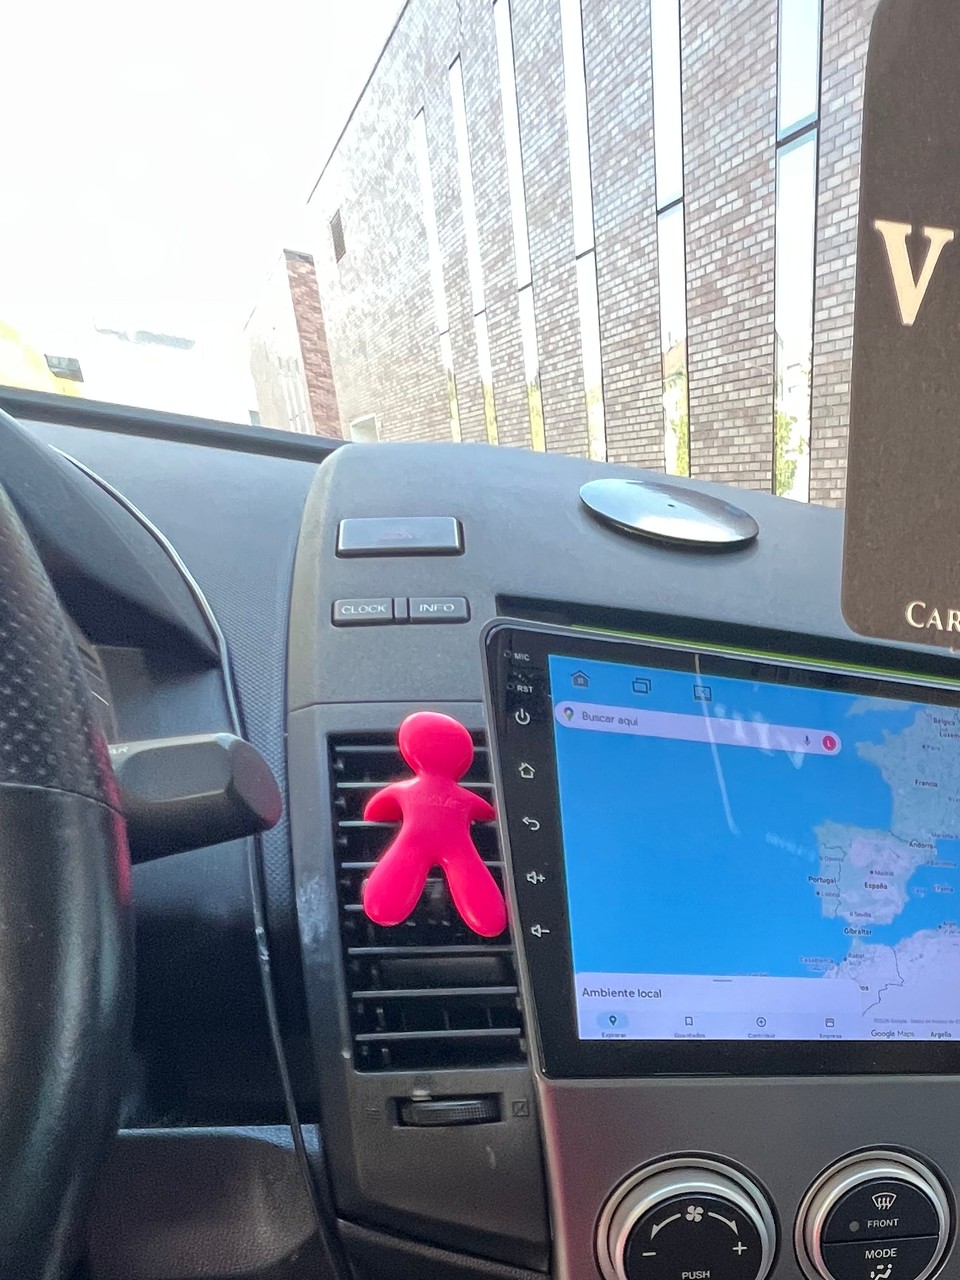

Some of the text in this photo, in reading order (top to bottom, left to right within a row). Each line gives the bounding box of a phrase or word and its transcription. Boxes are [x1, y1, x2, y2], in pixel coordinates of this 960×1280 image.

[341, 603, 387, 615] CLOCK
[418, 603, 455, 612] INFO
[513, 652, 530, 662] MIC
[516, 684, 533, 694] RST
[582, 711, 615, 723] Buscar
[914, 779, 938, 788] Francia
[908, 841, 934, 850] Andorra
[874, 869, 895, 877] Madrid
[808, 875, 837, 885] Portugal
[864, 881, 888, 890] España
[843, 927, 872, 935] Gibraltar
[582, 987, 662, 998] Ambiente local
[870, 1029, 915, 1039] Google Maps
[930, 1031, 952, 1039] Argelia
[867, 1218, 899, 1229] FRONT
[865, 1248, 898, 1260] MODE
[681, 1270, 710, 1280] PUSH
